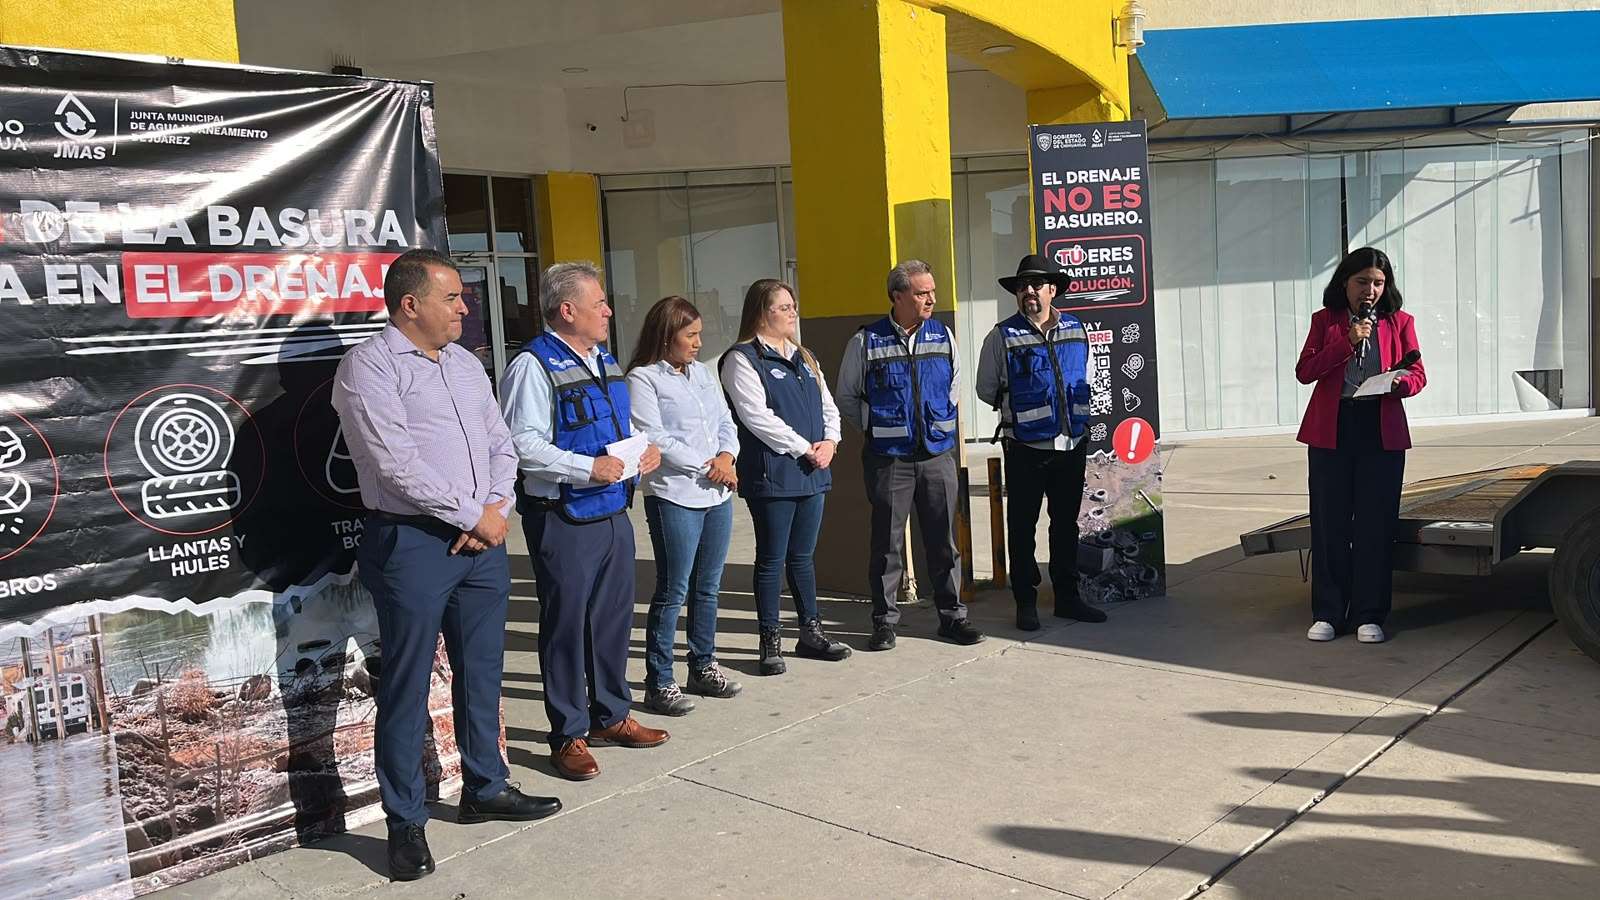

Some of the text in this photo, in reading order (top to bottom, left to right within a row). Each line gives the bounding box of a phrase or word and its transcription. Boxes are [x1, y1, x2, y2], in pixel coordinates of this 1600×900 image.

[130, 111, 165, 120] JUNTA
[130, 121, 146, 131] DE
[53, 144, 106, 160] JMAS
[1042, 167, 1141, 185] EL DRENAJE
[1043, 183, 1142, 213] NO ES
[20, 200, 409, 247] DE LA BASURA
[1044, 210, 1143, 230] BASURERO.
[1088, 246, 1133, 263] ERES
[1101, 265, 1116, 276] DE
[1119, 264, 1135, 275] LA
[44, 264, 121, 304] EN
[134, 263, 388, 303] EL DRENAJ
[1066, 275, 1135, 292] OLUCIÓN.
[1094, 321, 1102, 331] Y
[331, 517, 367, 535] TRA
[148, 534, 246, 562] LLANTAS Y
[171, 554, 230, 576] HULES
[0, 573, 57, 598] BROS
